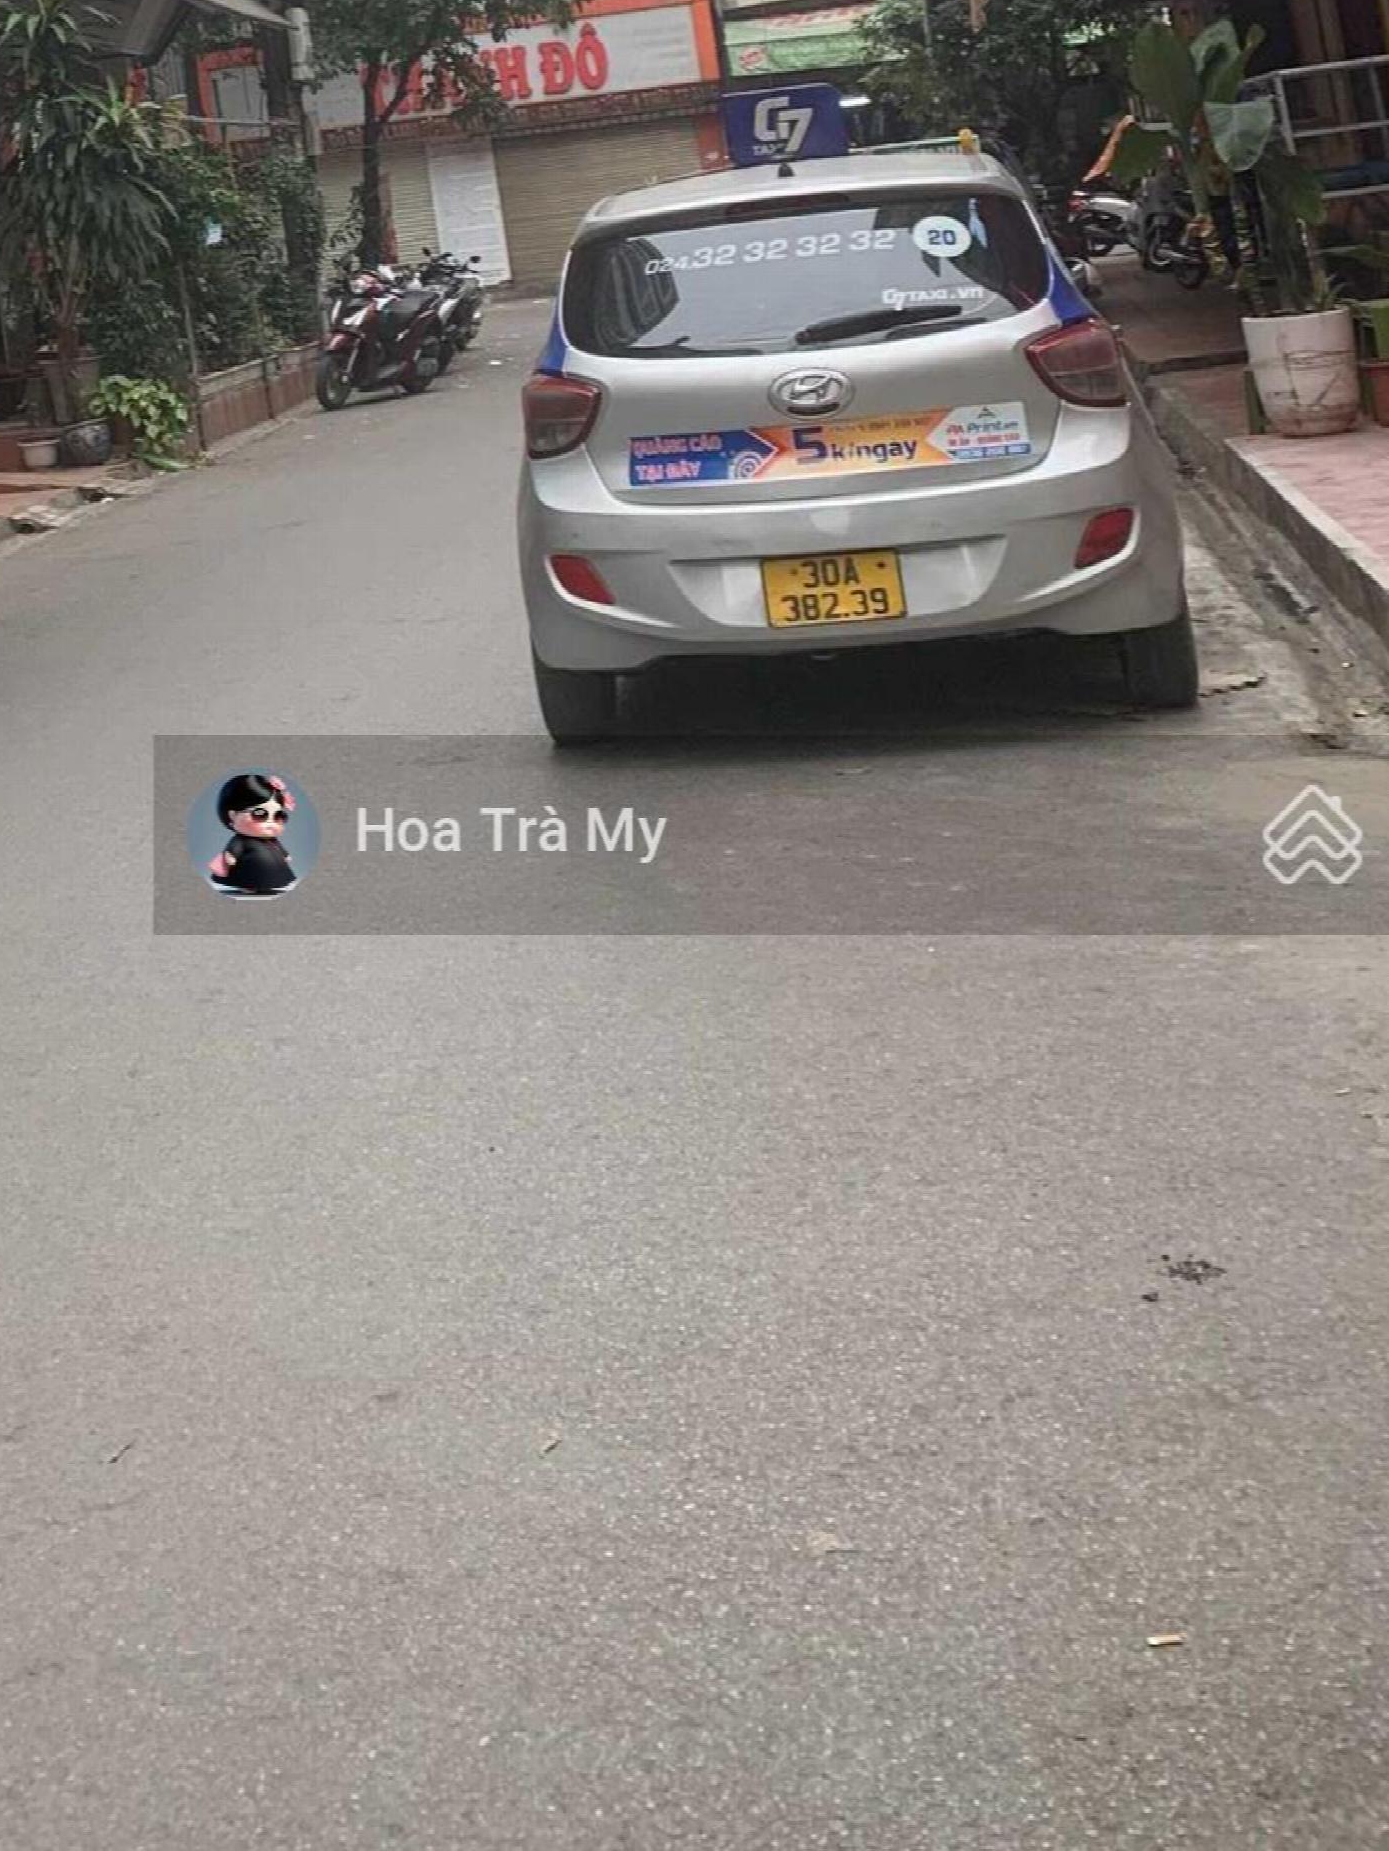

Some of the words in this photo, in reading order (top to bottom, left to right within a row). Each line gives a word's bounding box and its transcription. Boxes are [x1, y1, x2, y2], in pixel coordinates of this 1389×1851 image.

[538, 21, 608, 96] ĐÔ
[754, 96, 813, 153] G7
[743, 239, 788, 264] 32
[795, 232, 841, 257] 32
[850, 229, 896, 251] 32
[927, 229, 956, 246] 20
[801, 556, 860, 588] 30A
[781, 587, 889, 622] 382.39
